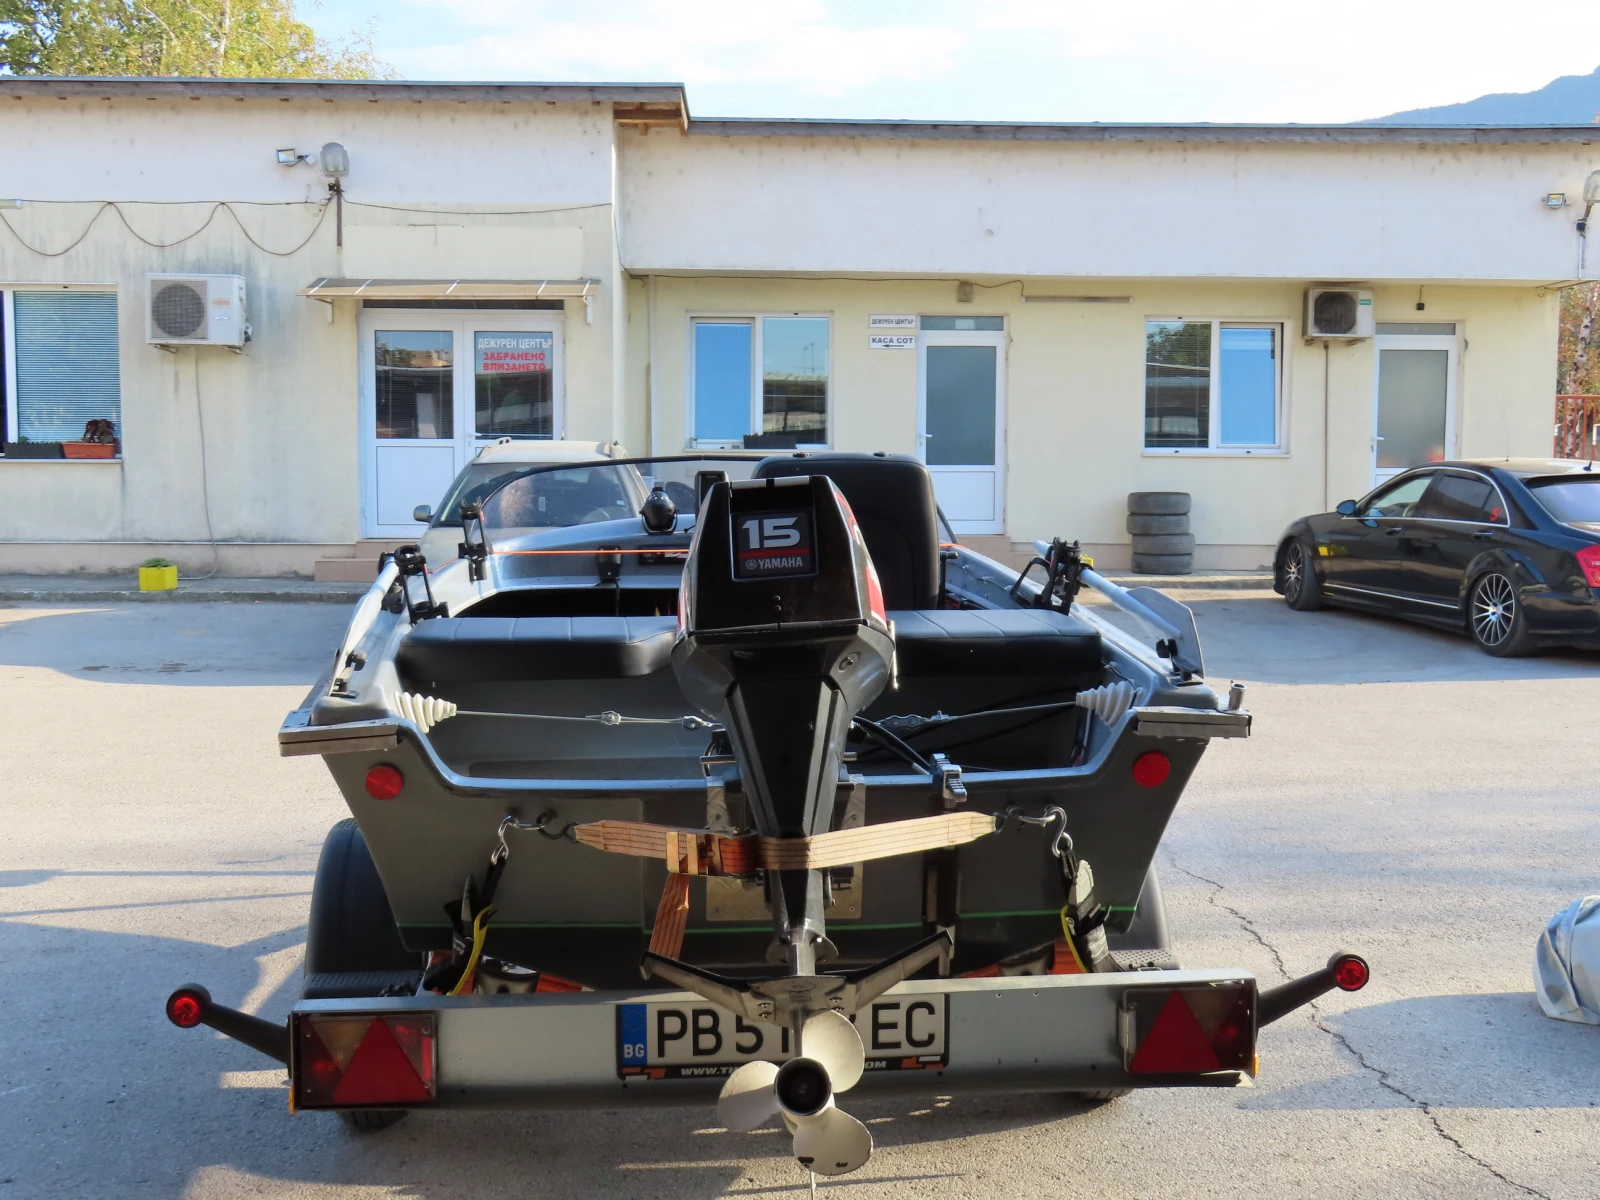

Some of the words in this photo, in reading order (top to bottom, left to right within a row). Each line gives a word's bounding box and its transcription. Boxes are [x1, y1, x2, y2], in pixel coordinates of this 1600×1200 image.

[478, 338, 517, 349] ДЕЖУРЕН
[482, 352, 546, 361] ЗАБРАНЕНО
[483, 363, 546, 371] ВЛИЗАНЕТО
[742, 517, 800, 549] 15
[758, 557, 803, 570] YAMAHA
[657, 1008, 723, 1058] PB
[871, 1001, 936, 1051] EC
[623, 1043, 645, 1059] BG
